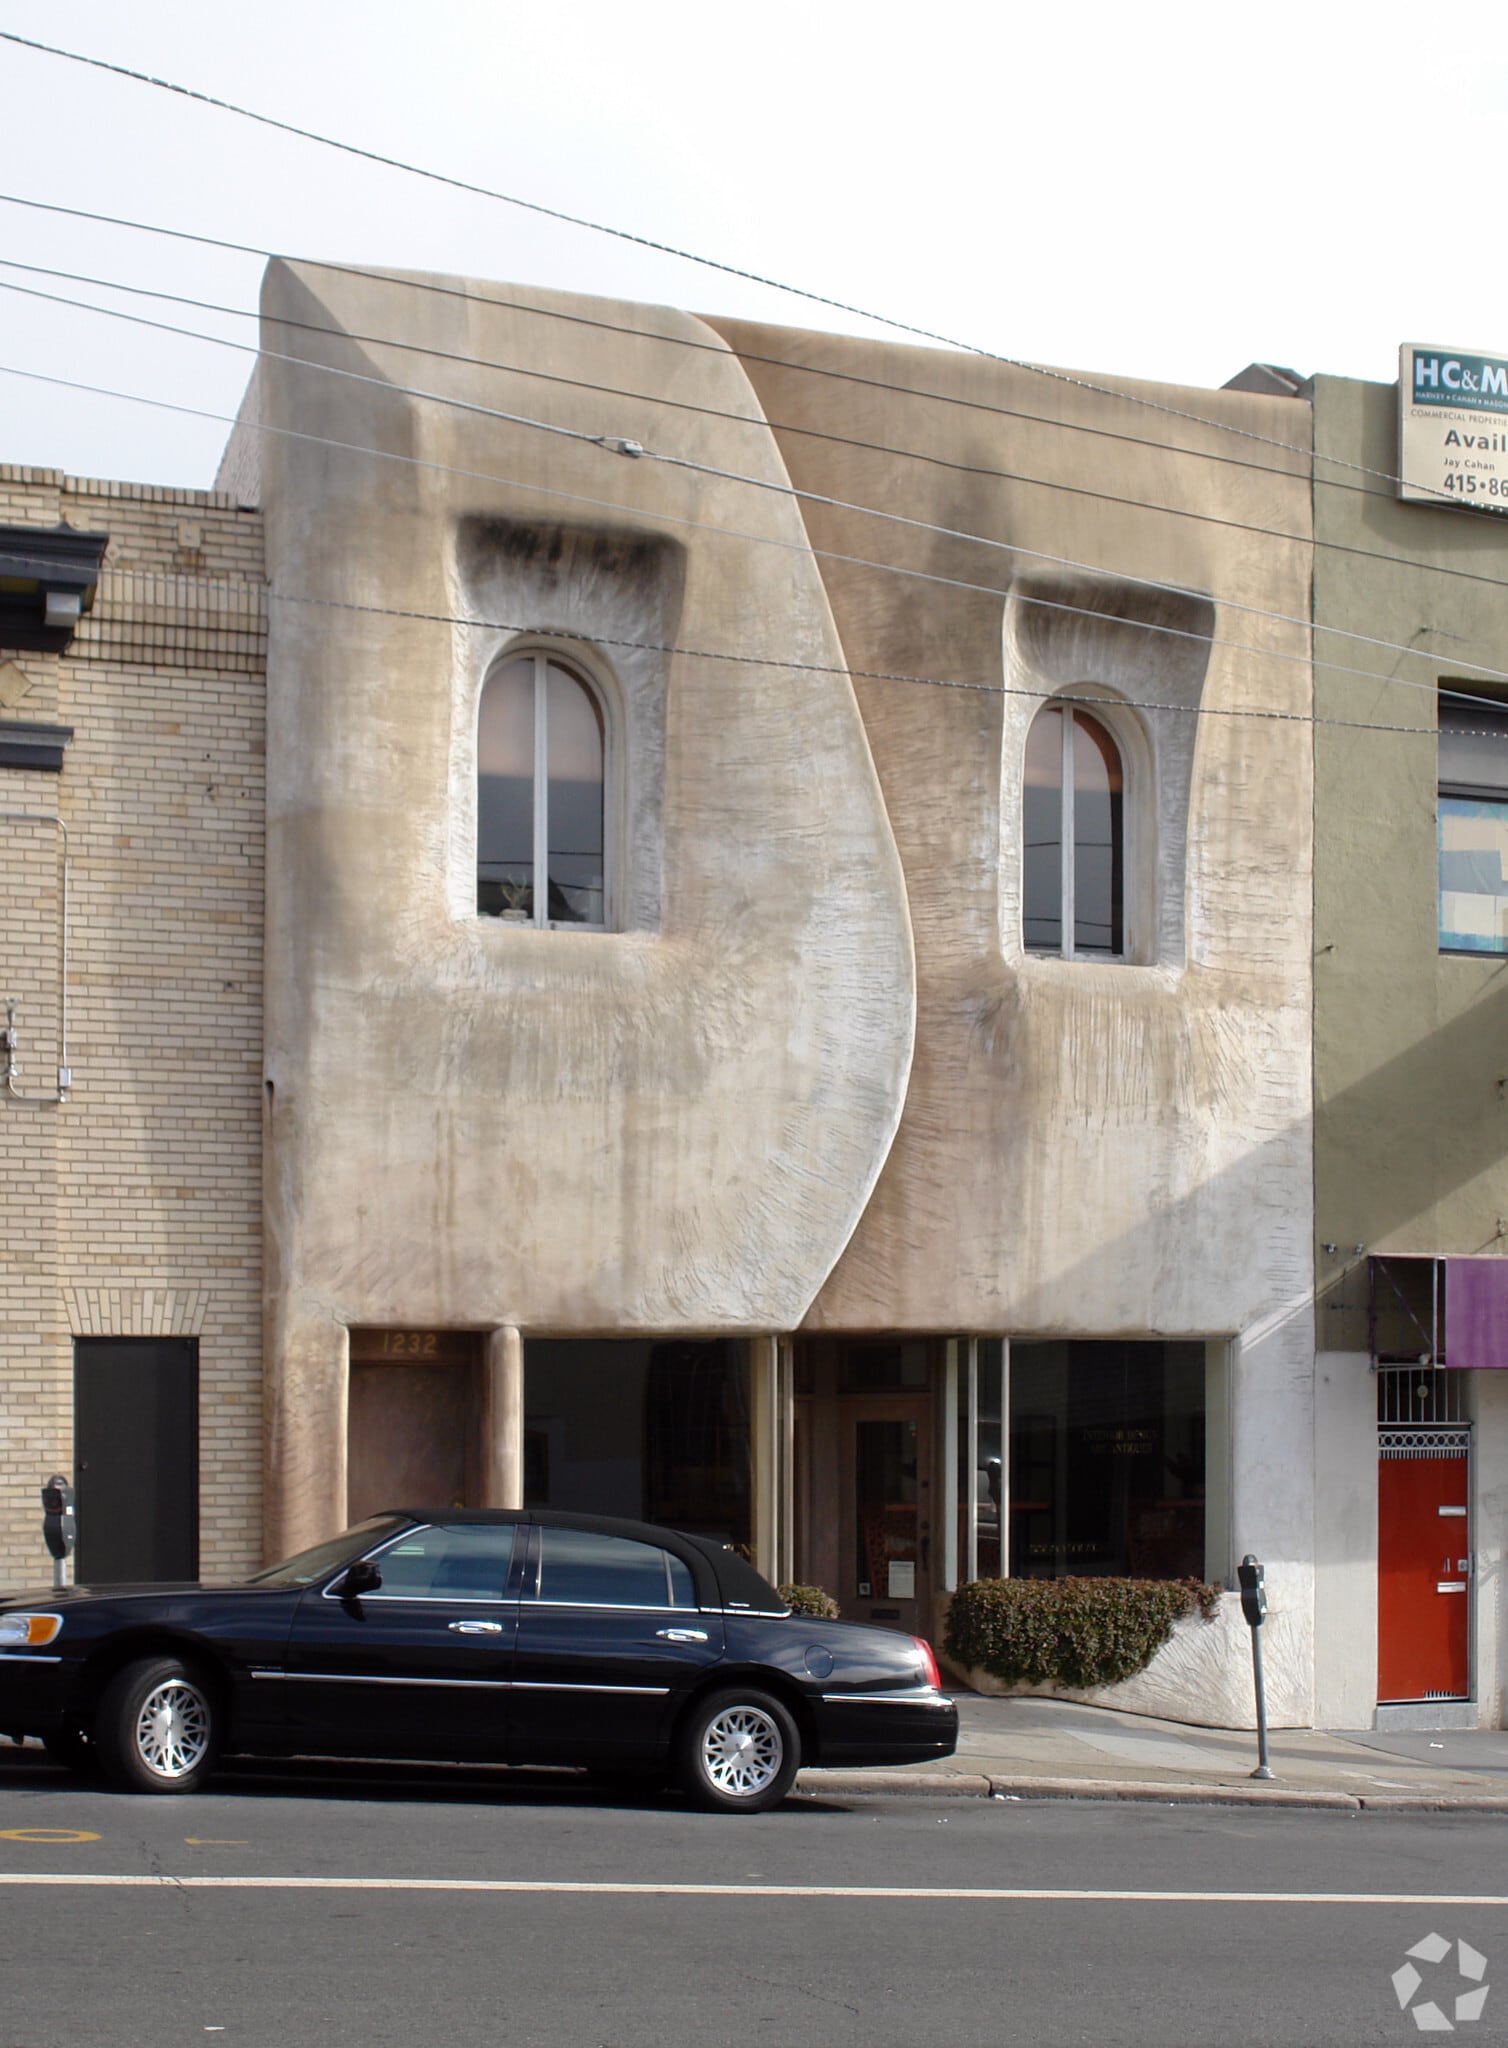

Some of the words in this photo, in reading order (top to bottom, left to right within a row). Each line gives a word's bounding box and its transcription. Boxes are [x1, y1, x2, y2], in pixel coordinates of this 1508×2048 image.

[1416, 357, 1508, 396] HC&M
[1451, 394, 1477, 404] CAHAN
[1410, 408, 1466, 422] COMMERCIAL
[1445, 429, 1506, 452] Avail
[1444, 457, 1460, 469] Jay
[1464, 459, 1496, 471] Cahan
[383, 1332, 438, 1355] 1232
